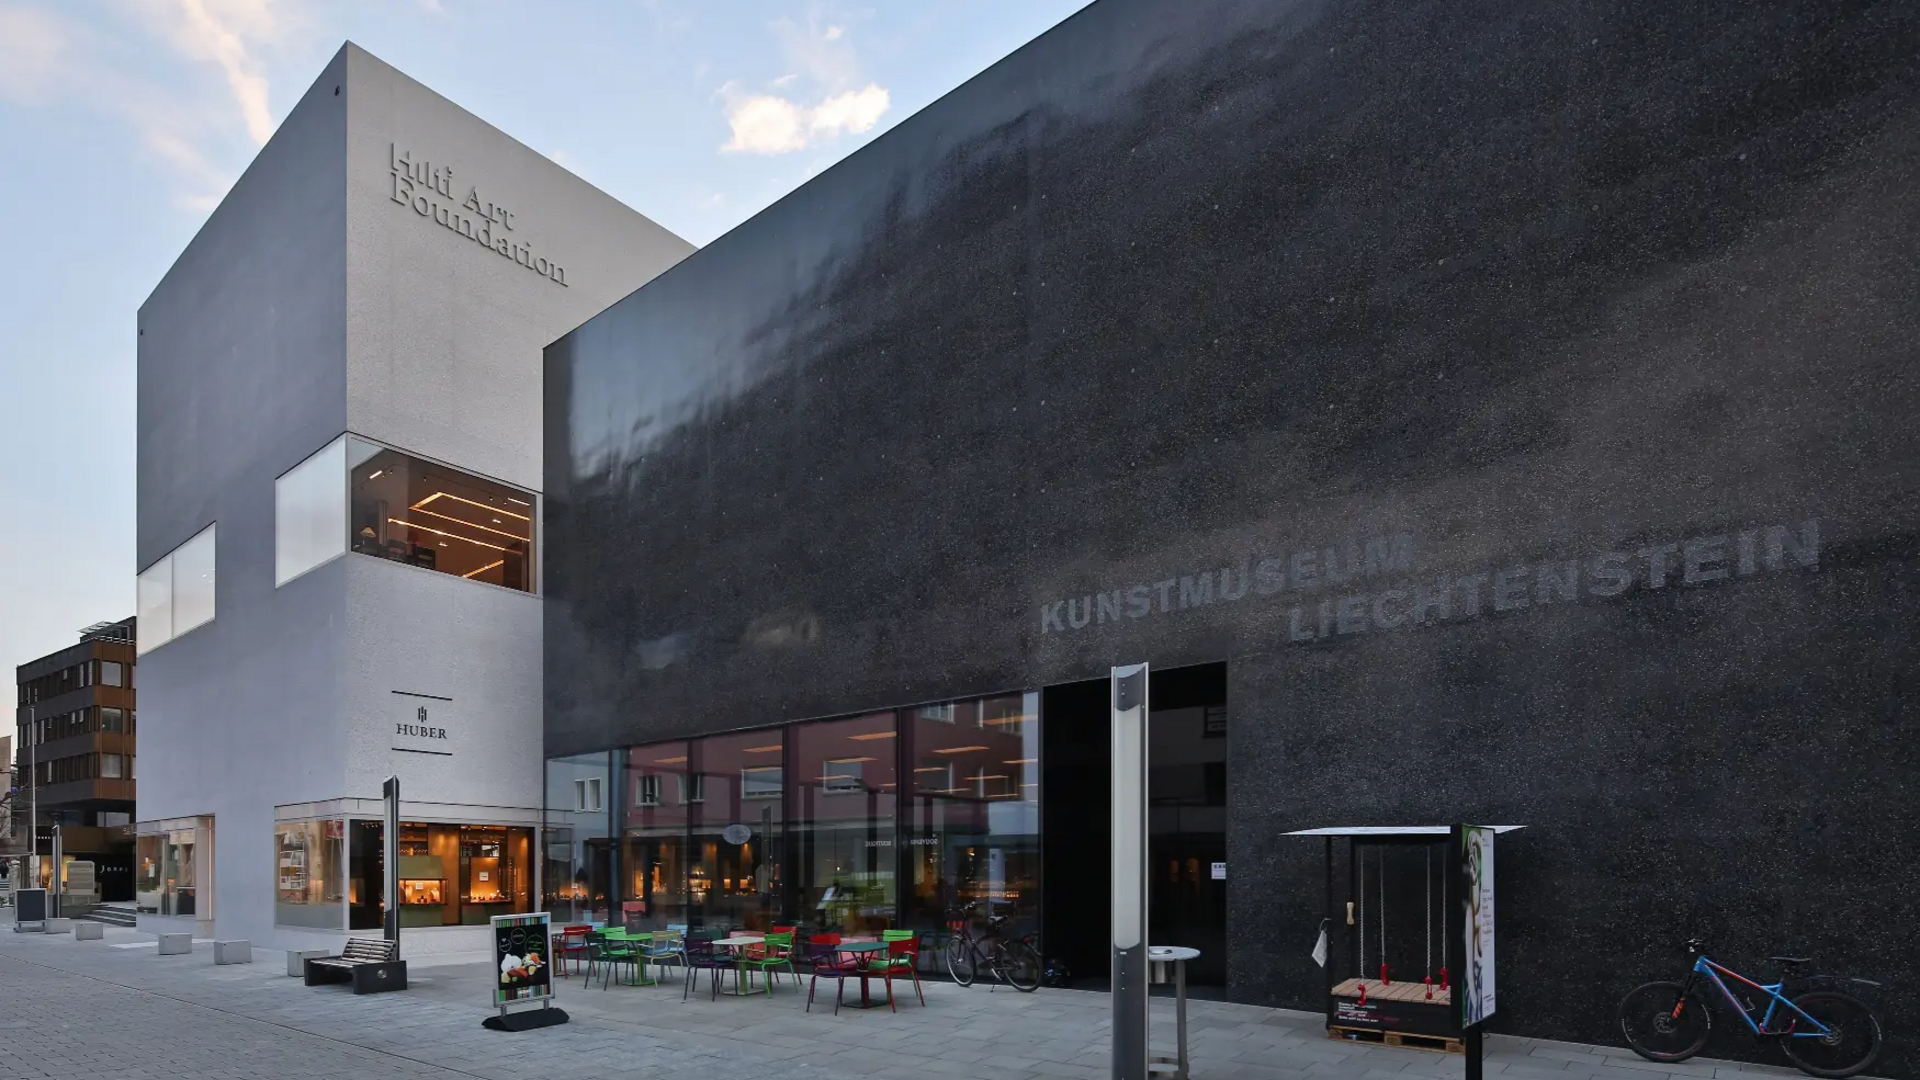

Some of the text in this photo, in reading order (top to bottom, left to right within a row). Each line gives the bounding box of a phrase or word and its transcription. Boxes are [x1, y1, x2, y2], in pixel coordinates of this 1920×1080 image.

[390, 142, 515, 231] Hilti Art
[390, 172, 569, 288] Foundation
[1040, 534, 1415, 634] KUNSTMUSEUM
[1289, 518, 1821, 642] LIECHTENSTEIN
[396, 723, 448, 740] HUBER
